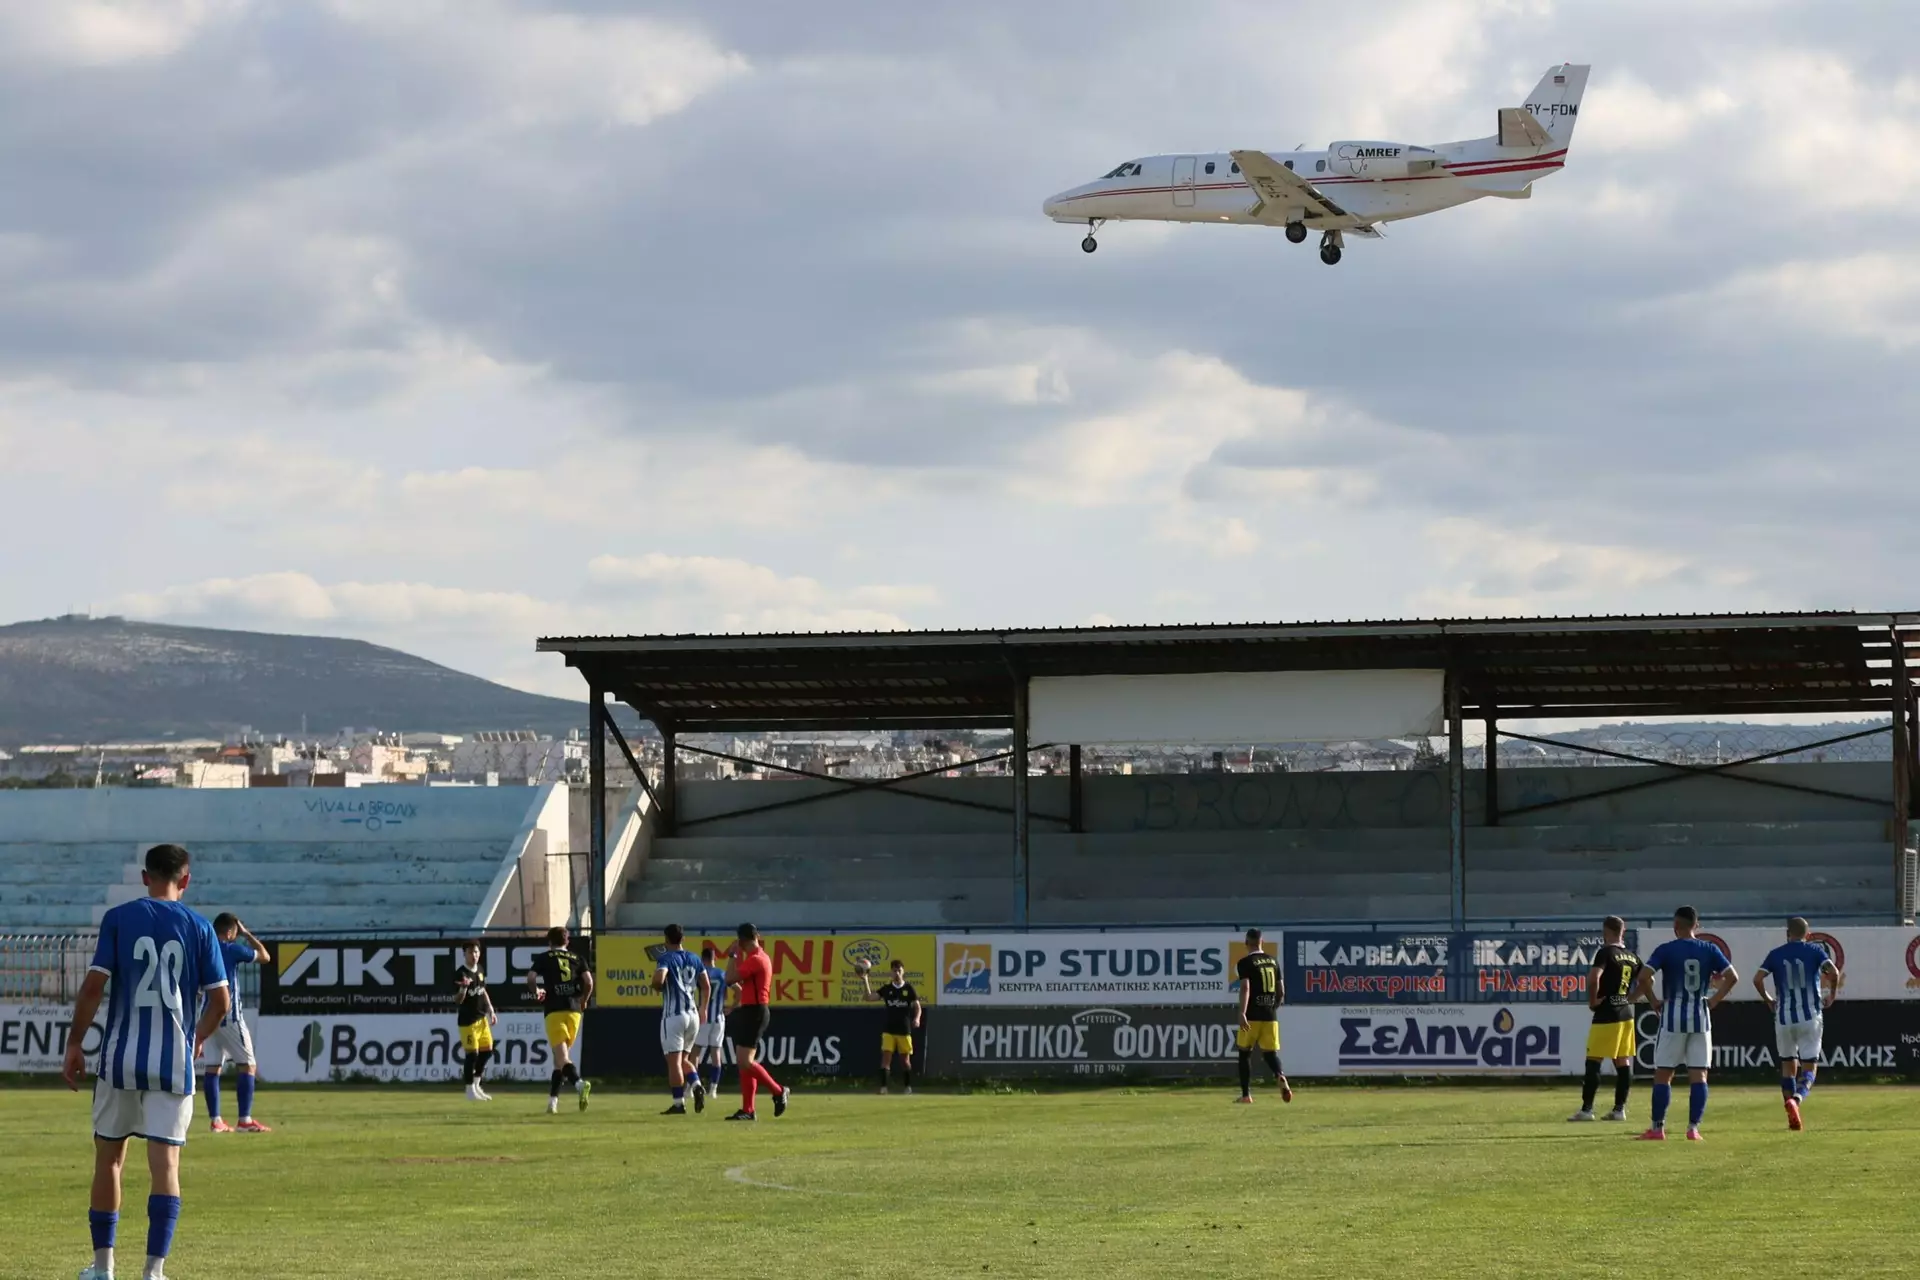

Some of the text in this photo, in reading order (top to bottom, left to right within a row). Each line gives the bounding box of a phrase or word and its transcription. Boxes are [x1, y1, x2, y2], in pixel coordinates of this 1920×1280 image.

[1356, 148, 1401, 158] AMREF
[1405, 936, 1448, 946] euronics
[133, 936, 185, 1009] 20
[606, 968, 645, 981] ΨΙΛΙΚΑ
[998, 948, 1223, 977] DP STUDIES
[1684, 959, 1700, 992] 8
[1782, 958, 1806, 990] 11
[998, 982, 1043, 992] ΚΕΝΤΡΑ
[1046, 981, 1150, 992] ΕΠΑΓΓΕΛΜΑΤΙΚΗΣ
[1152, 981, 1224, 991] ΚΑΤΑΡΤΙΣΗΣ
[1260, 966, 1276, 993] 10
[1305, 968, 1445, 998] Ηλεκτρικά
[1478, 968, 1586, 998] Ηλεκτρι
[281, 994, 457, 1007] Construction Planning Real estat
[962, 1023, 1239, 1058] ΚΡΗΤΙΚΟΣ ΦΟΥΡΝΟΣ
